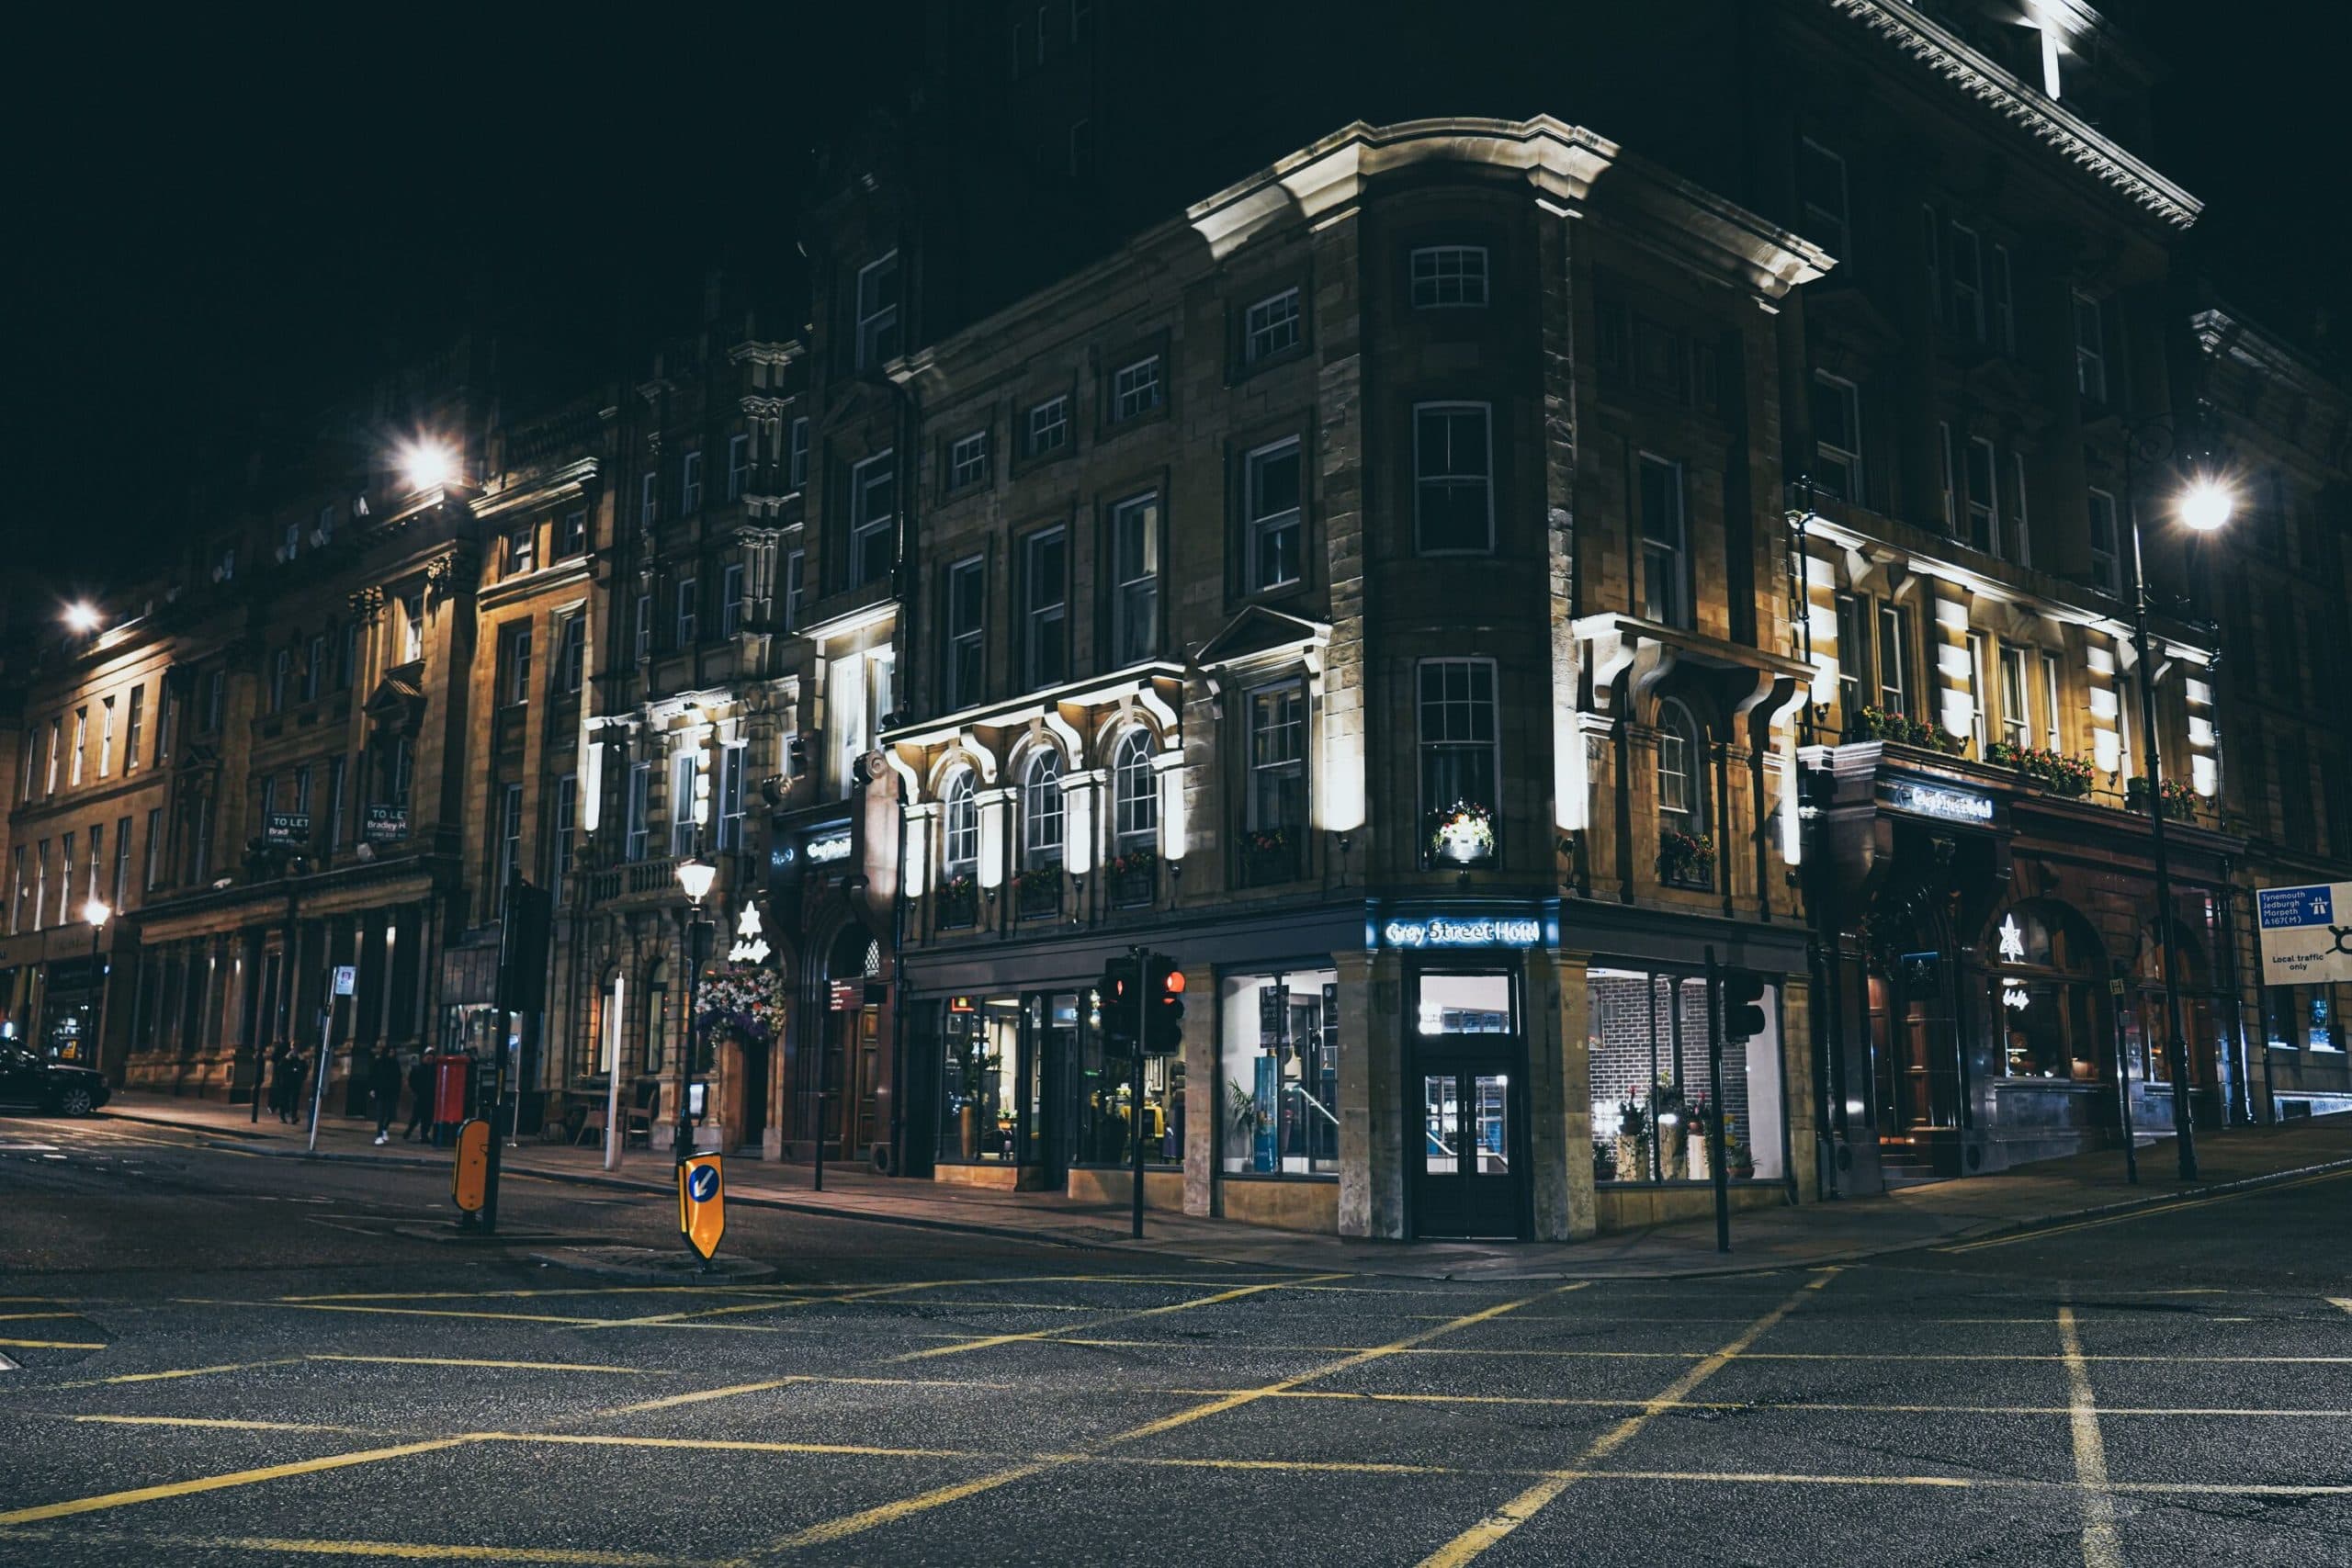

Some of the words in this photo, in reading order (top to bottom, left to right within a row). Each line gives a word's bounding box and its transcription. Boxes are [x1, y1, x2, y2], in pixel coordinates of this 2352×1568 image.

[372, 809, 387, 819] TO
[390, 810, 408, 820] LE
[273, 817, 288, 827] TO
[289, 818, 310, 828] LET
[2262, 891, 2306, 901] Tynemouth
[2263, 900, 2301, 909] Jedburgh
[2264, 908, 2299, 917] Morpeth
[2264, 916, 2301, 925] A167(M)
[1385, 921, 1426, 947] Grey
[1428, 920, 1494, 942] Street
[2272, 955, 2295, 964] Local
[2297, 953, 2324, 962] traffic
[2289, 963, 2308, 971] only
